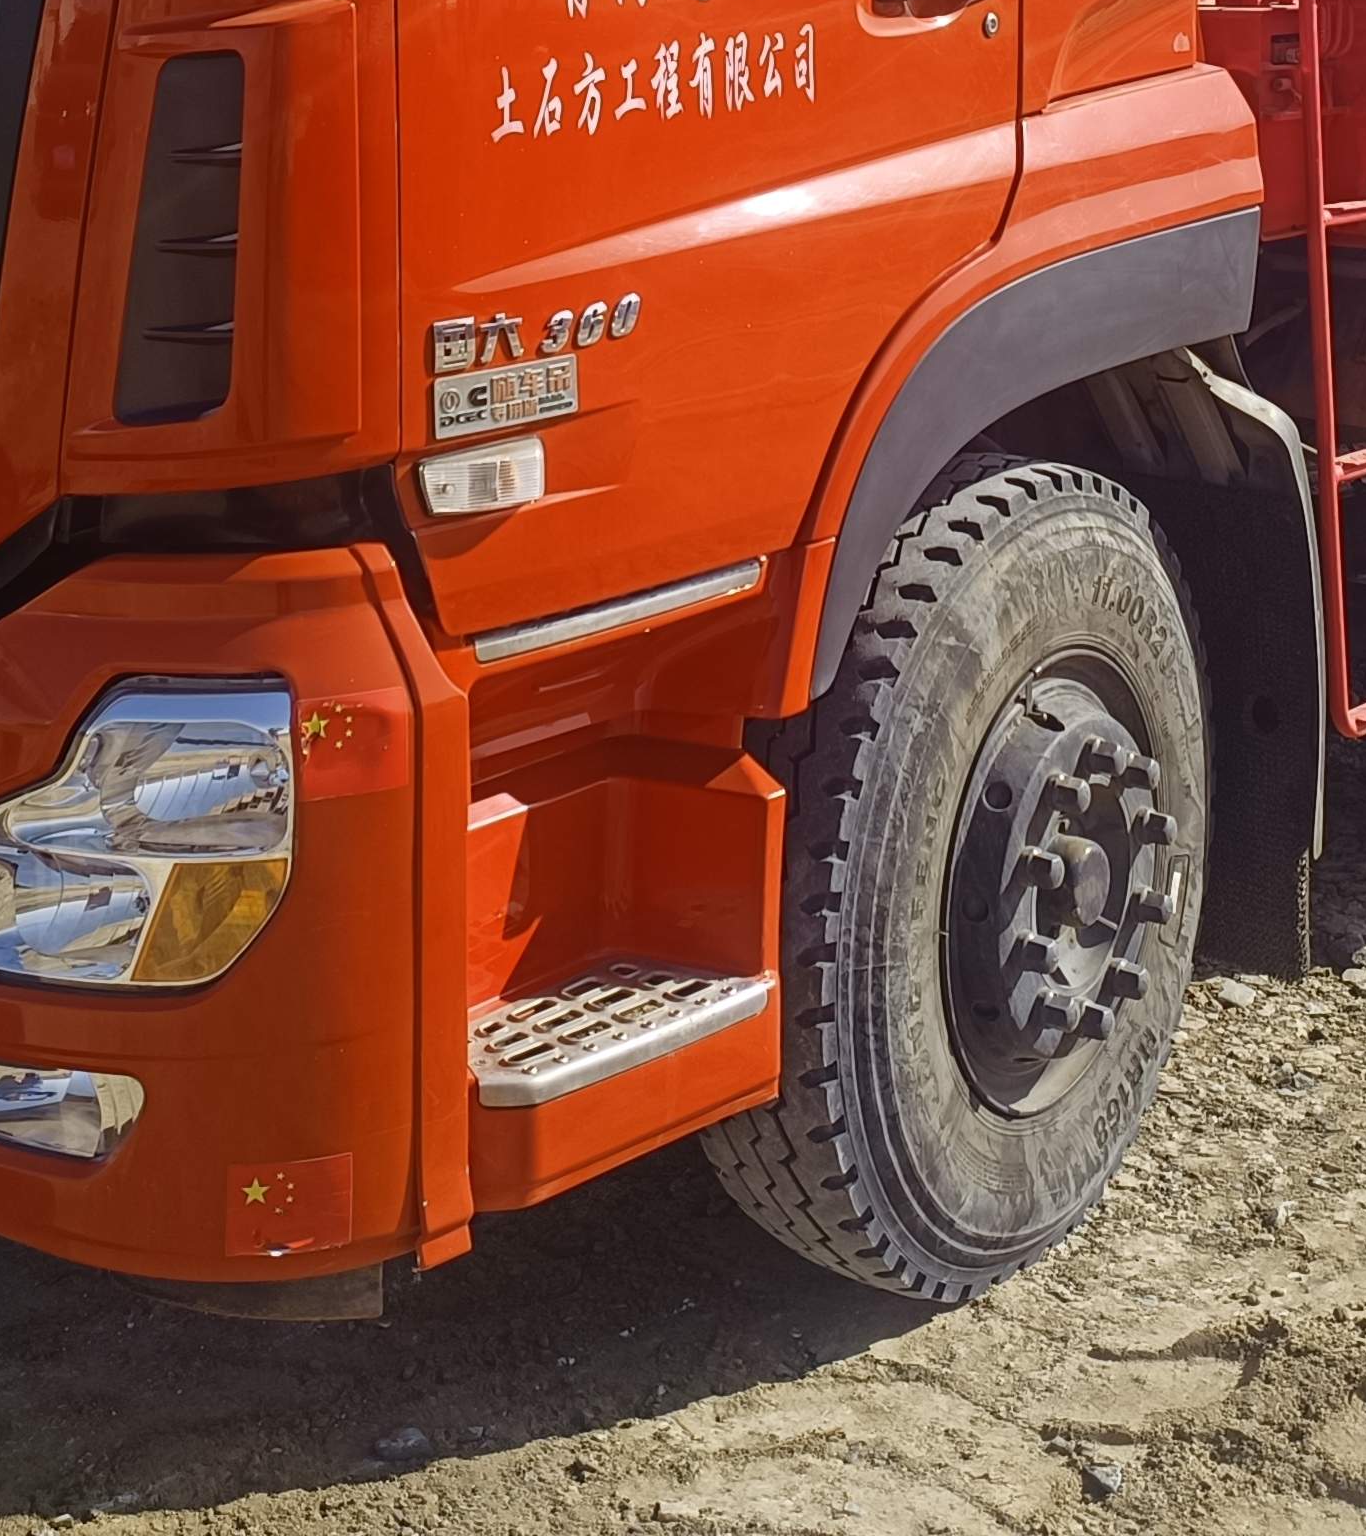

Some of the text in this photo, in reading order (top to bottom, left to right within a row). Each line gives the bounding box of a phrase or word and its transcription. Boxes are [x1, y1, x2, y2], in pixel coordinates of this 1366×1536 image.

[489, 22, 818, 145] 土石方工程有限公司
[433, 292, 641, 374] 国六 360
